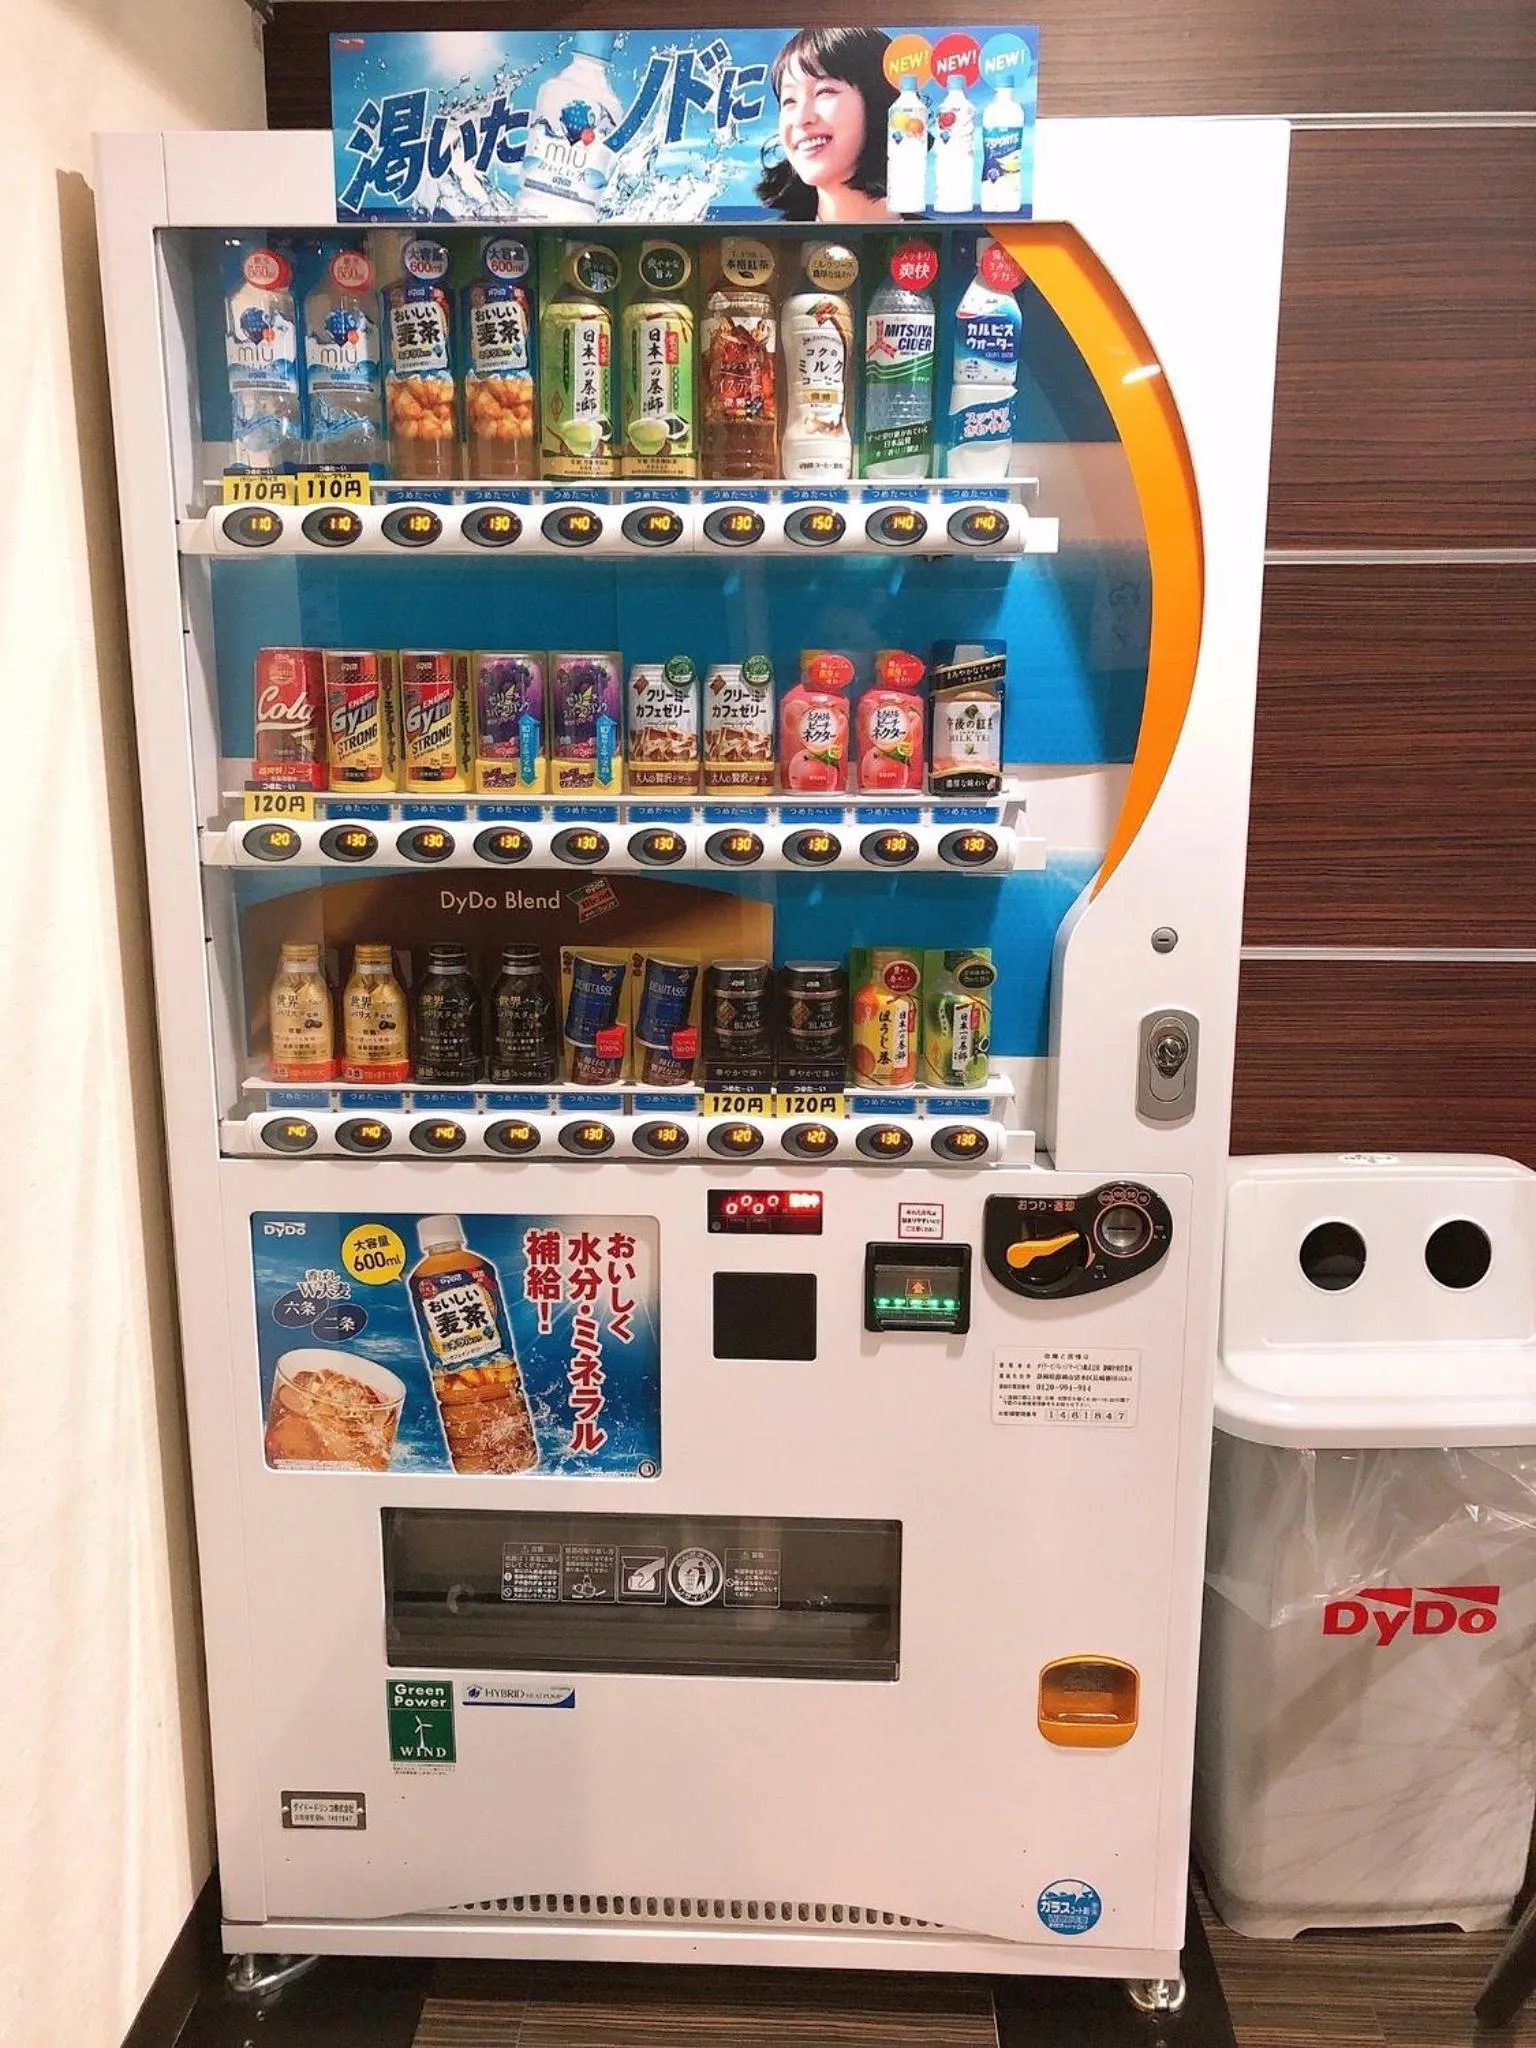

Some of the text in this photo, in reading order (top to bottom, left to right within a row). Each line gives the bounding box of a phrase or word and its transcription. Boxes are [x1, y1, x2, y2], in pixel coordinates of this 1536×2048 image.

[888, 42, 929, 75] NEW!
[936, 41, 978, 74] NEW!
[985, 47, 1025, 73] NEW!
[339, 38, 768, 214] 渇いた ノドに
[545, 143, 588, 168] miu
[409, 261, 443, 273] 600ml
[490, 260, 524, 272] 600ml
[897, 265, 931, 280] 爽快
[393, 306, 437, 322] おいしい
[474, 306, 517, 322] おいしい
[396, 320, 440, 347] 麦茶
[476, 320, 521, 347] 麦茶
[884, 324, 932, 338] MITSUYA
[967, 323, 1014, 337] カルピス
[806, 347, 838, 357] コクの
[898, 338, 932, 351] CIDER
[238, 347, 274, 362] miu
[320, 347, 358, 363] miu
[799, 361, 843, 373] ミルク
[233, 482, 287, 500] 110円
[308, 480, 362, 498] 110円
[251, 516, 272, 531] 110
[330, 516, 351, 531] 110
[410, 516, 431, 531] 130
[490, 516, 510, 531] 130
[570, 516, 591, 531] 140
[650, 516, 671, 531] 140
[731, 515, 752, 531] 130
[812, 515, 833, 531] 150
[892, 515, 915, 530] 140
[974, 515, 996, 530] 140
[646, 689, 690, 702] クリーミー
[723, 689, 767, 702] クリーミー
[257, 685, 314, 722] Cola
[635, 705, 691, 718] カフェゼリー
[712, 705, 767, 718] カフェゼリー
[337, 723, 378, 755] STRONG
[411, 721, 452, 752] STRONG
[802, 730, 836, 742] ネクター
[872, 727, 906, 739] ネクター
[254, 795, 306, 812] 120円
[270, 832, 290, 846] 120
[345, 833, 367, 847] 130
[423, 833, 444, 848] 130
[499, 835, 520, 849] 130
[576, 836, 597, 850] 130
[654, 836, 675, 850] 130
[732, 837, 752, 851] 130
[808, 837, 829, 851] 130
[885, 838, 907, 851] 130
[963, 838, 985, 851] 130
[440, 889, 561, 915] DyDo Blend
[876, 1010, 892, 1065] ほうじ茶
[713, 1096, 764, 1113] 120円
[786, 1097, 836, 1113] 120円
[288, 1125, 306, 1138] 140
[361, 1125, 381, 1139] 140
[436, 1126, 455, 1139] 140
[510, 1127, 529, 1140] 140
[584, 1127, 603, 1141] 130
[656, 1128, 677, 1141] 130
[732, 1128, 752, 1143] 120
[807, 1129, 827, 1144] 120
[880, 1132, 901, 1145] 130
[955, 1133, 976, 1146] 130
[264, 1222, 306, 1237] DyDo
[353, 1234, 391, 1252] 大容量
[353, 1251, 402, 1272] 600ml
[526, 1231, 561, 1332] 補給!
[607, 1231, 637, 1341] おいしく
[283, 1300, 316, 1316] 六条
[428, 1288, 480, 1314] おいしい
[323, 1315, 356, 1332] 二条
[434, 1303, 489, 1339] 麦茶
[567, 1232, 605, 1451] 水分・ミネラル
[1322, 1588, 1500, 1646] DyDo
[394, 1683, 444, 1697] Green
[485, 1688, 525, 1698] HYBRID
[394, 1696, 447, 1708] Power
[400, 1746, 446, 1758] WIND
[1040, 1901, 1070, 1914] ガラス
